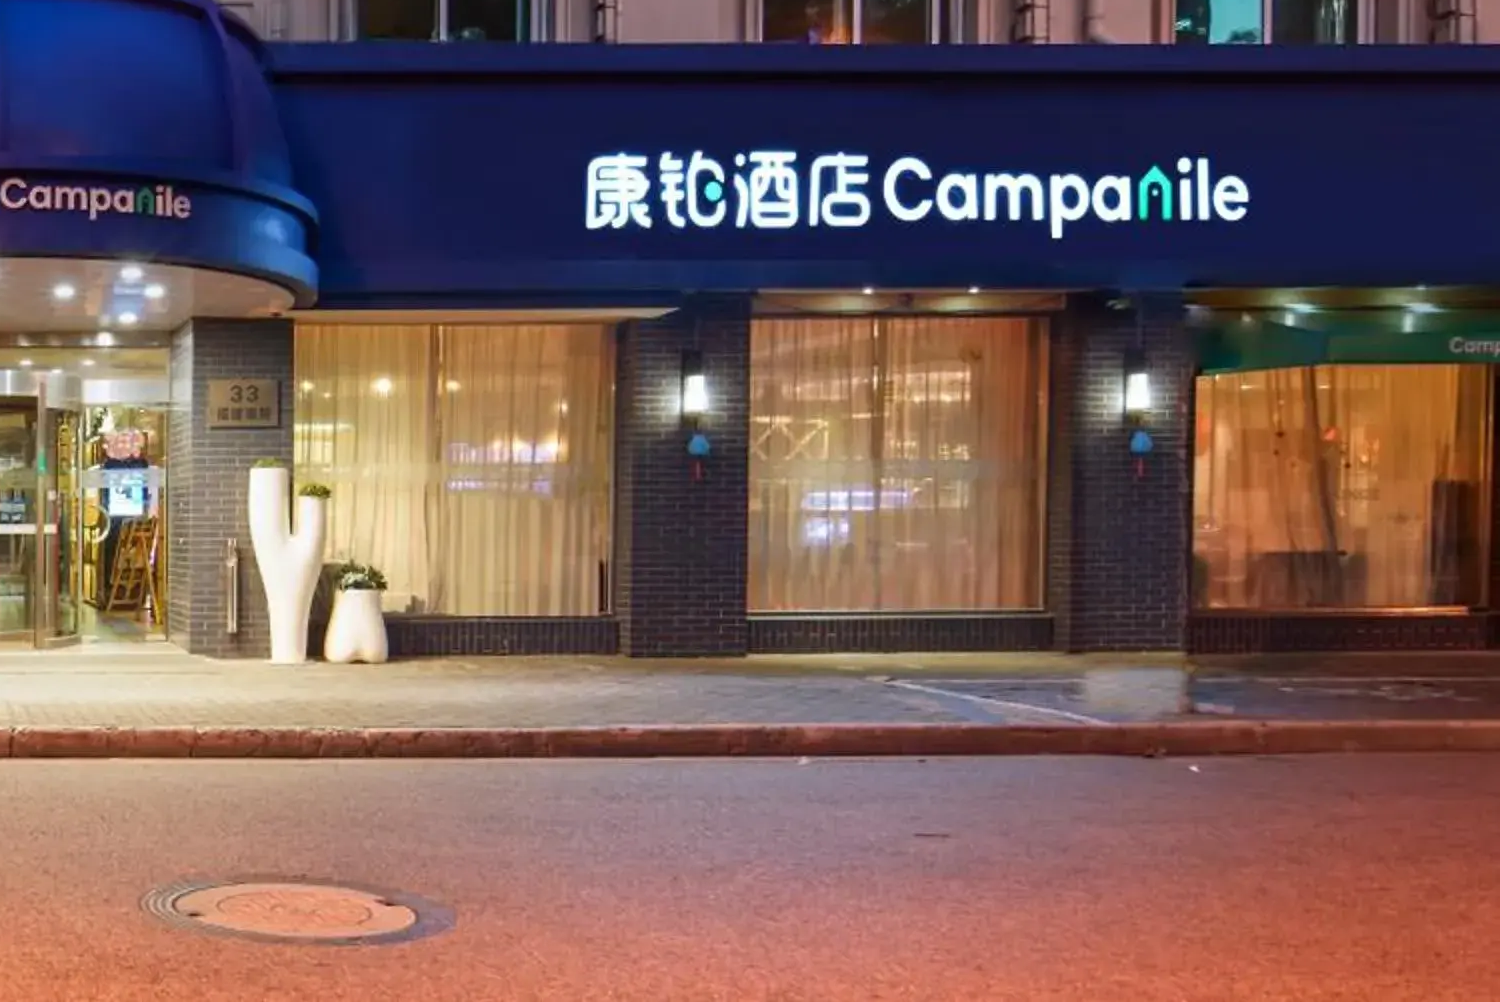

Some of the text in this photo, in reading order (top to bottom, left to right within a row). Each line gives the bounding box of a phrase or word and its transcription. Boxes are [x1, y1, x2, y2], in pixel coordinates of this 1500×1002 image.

[0, 178, 191, 220] Campanile
[883, 157, 1250, 238] Campanile
[230, 385, 259, 403] 33
